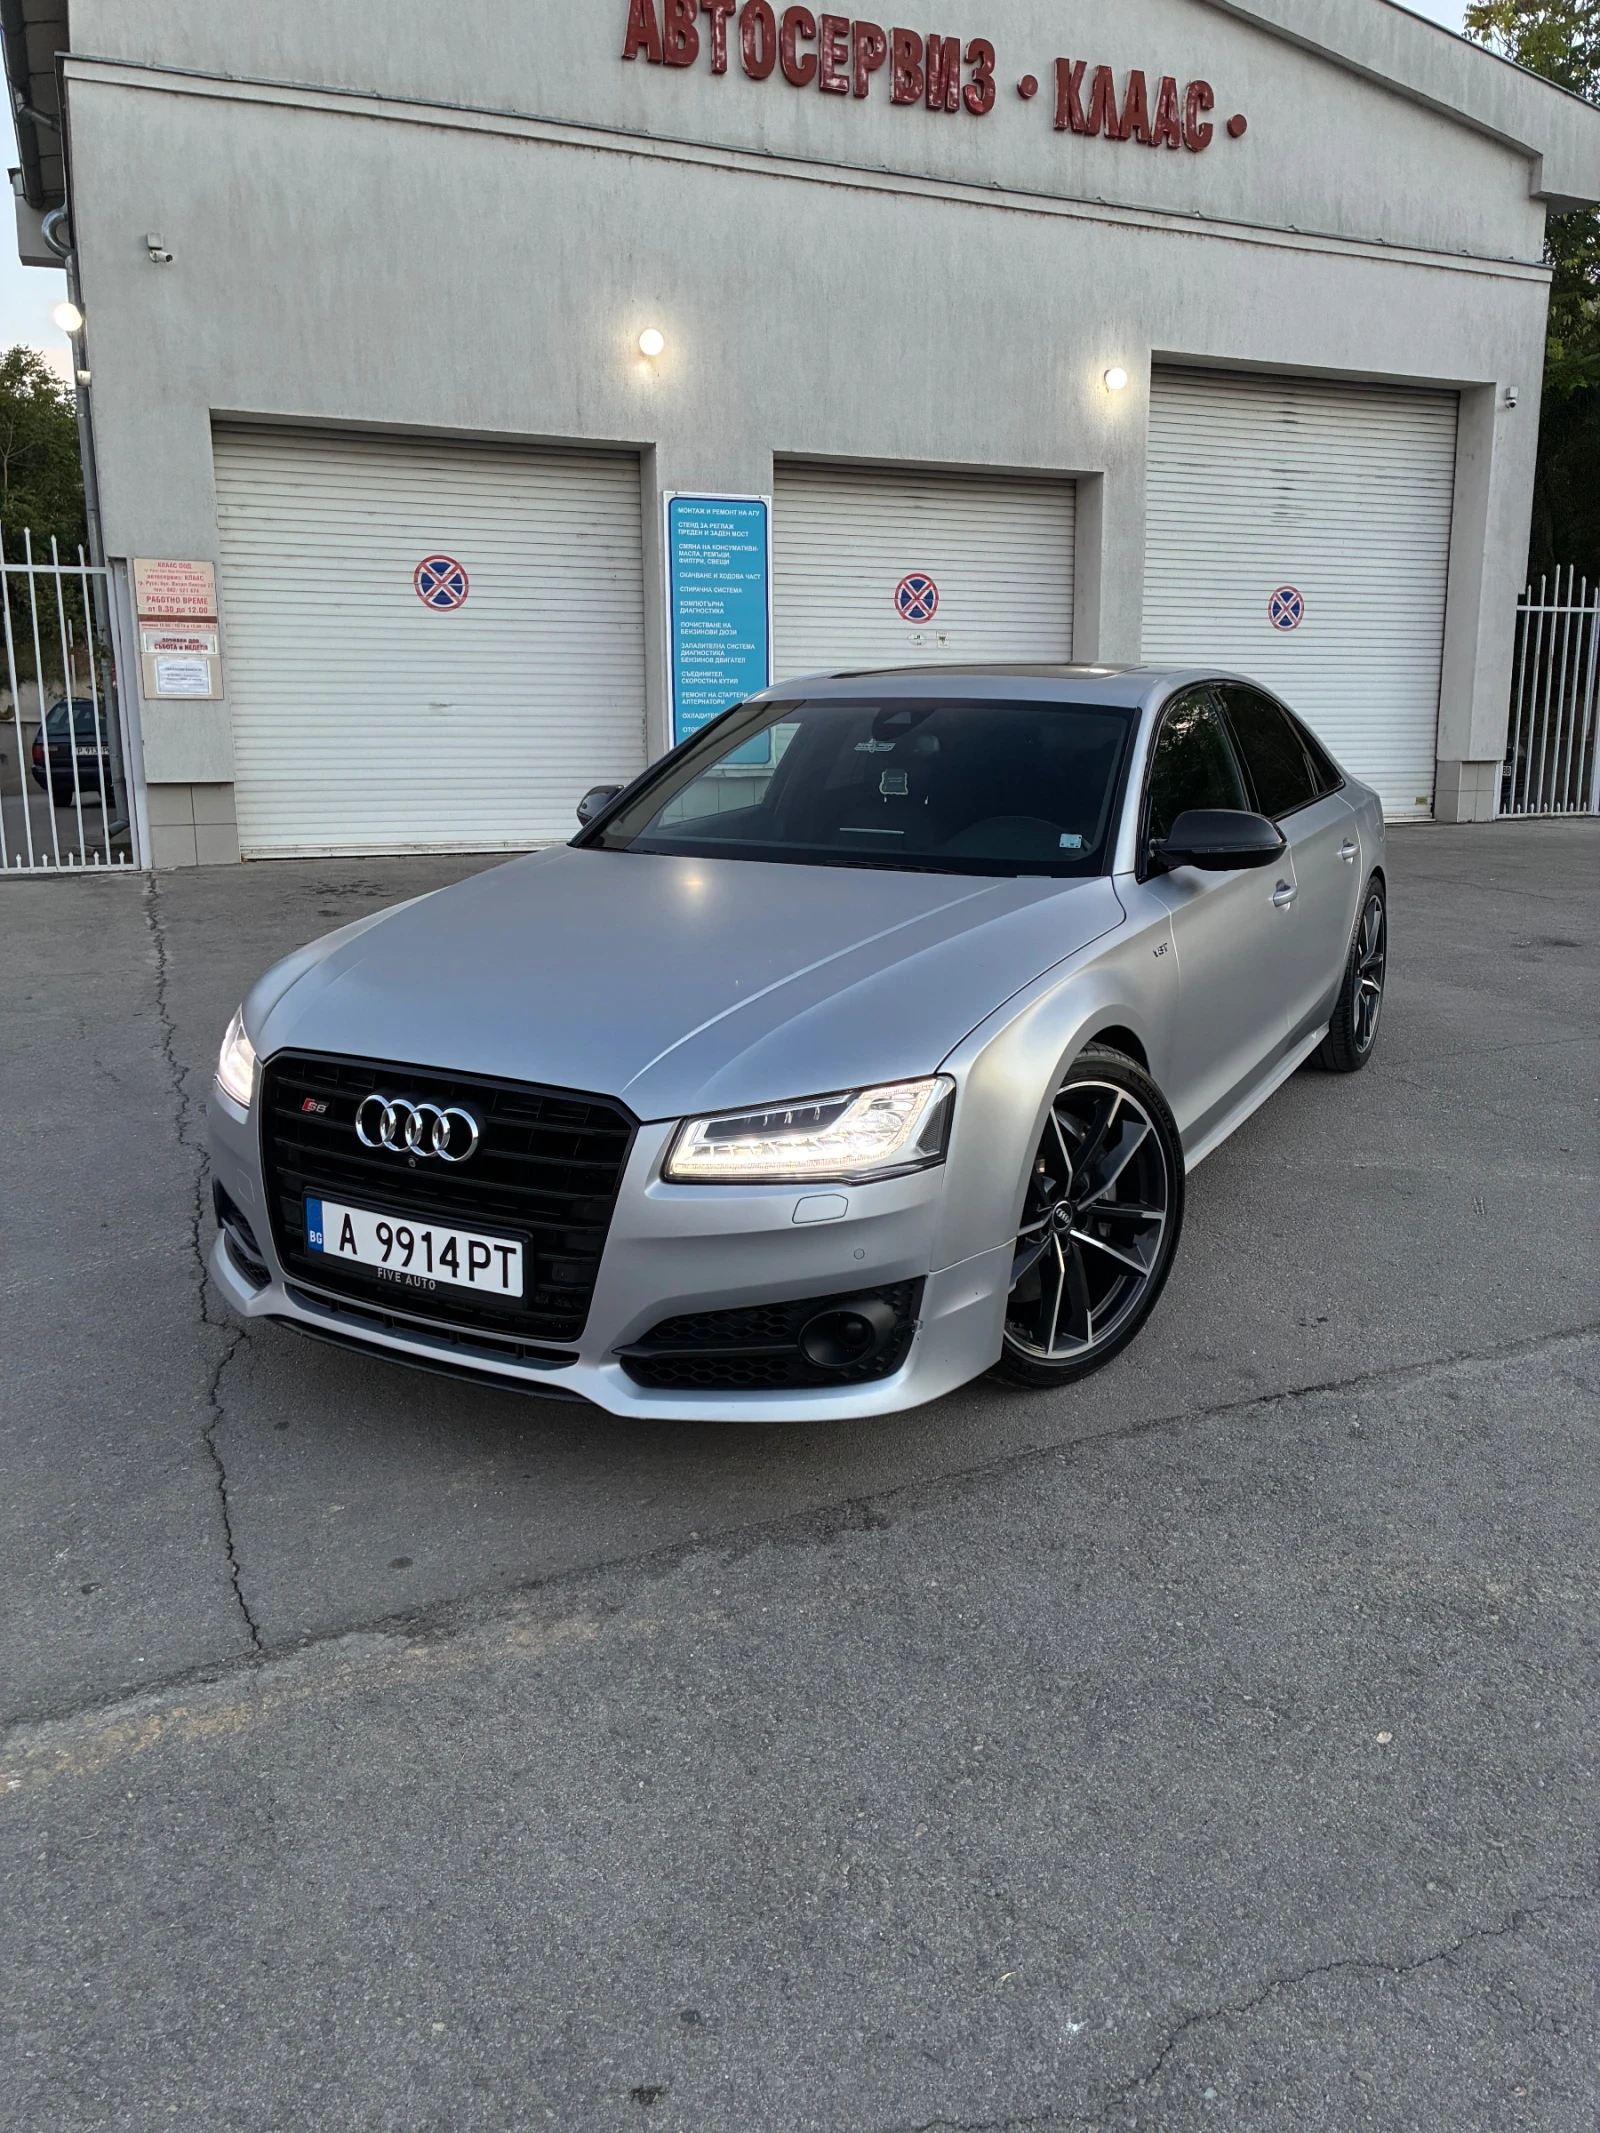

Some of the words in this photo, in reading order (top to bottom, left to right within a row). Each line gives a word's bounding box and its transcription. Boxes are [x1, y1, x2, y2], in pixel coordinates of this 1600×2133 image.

[622, 0, 995, 115] АВТОСЕРВИЗ
[1053, 56, 1214, 152] КЛААС
[146, 596, 180, 604] РАБОТНО
[306, 1102, 327, 1113] S8
[309, 1230, 322, 1245] BG
[339, 1213, 358, 1255] A
[377, 1267, 401, 1282] FIVE
[405, 1276, 436, 1290] AUTO
